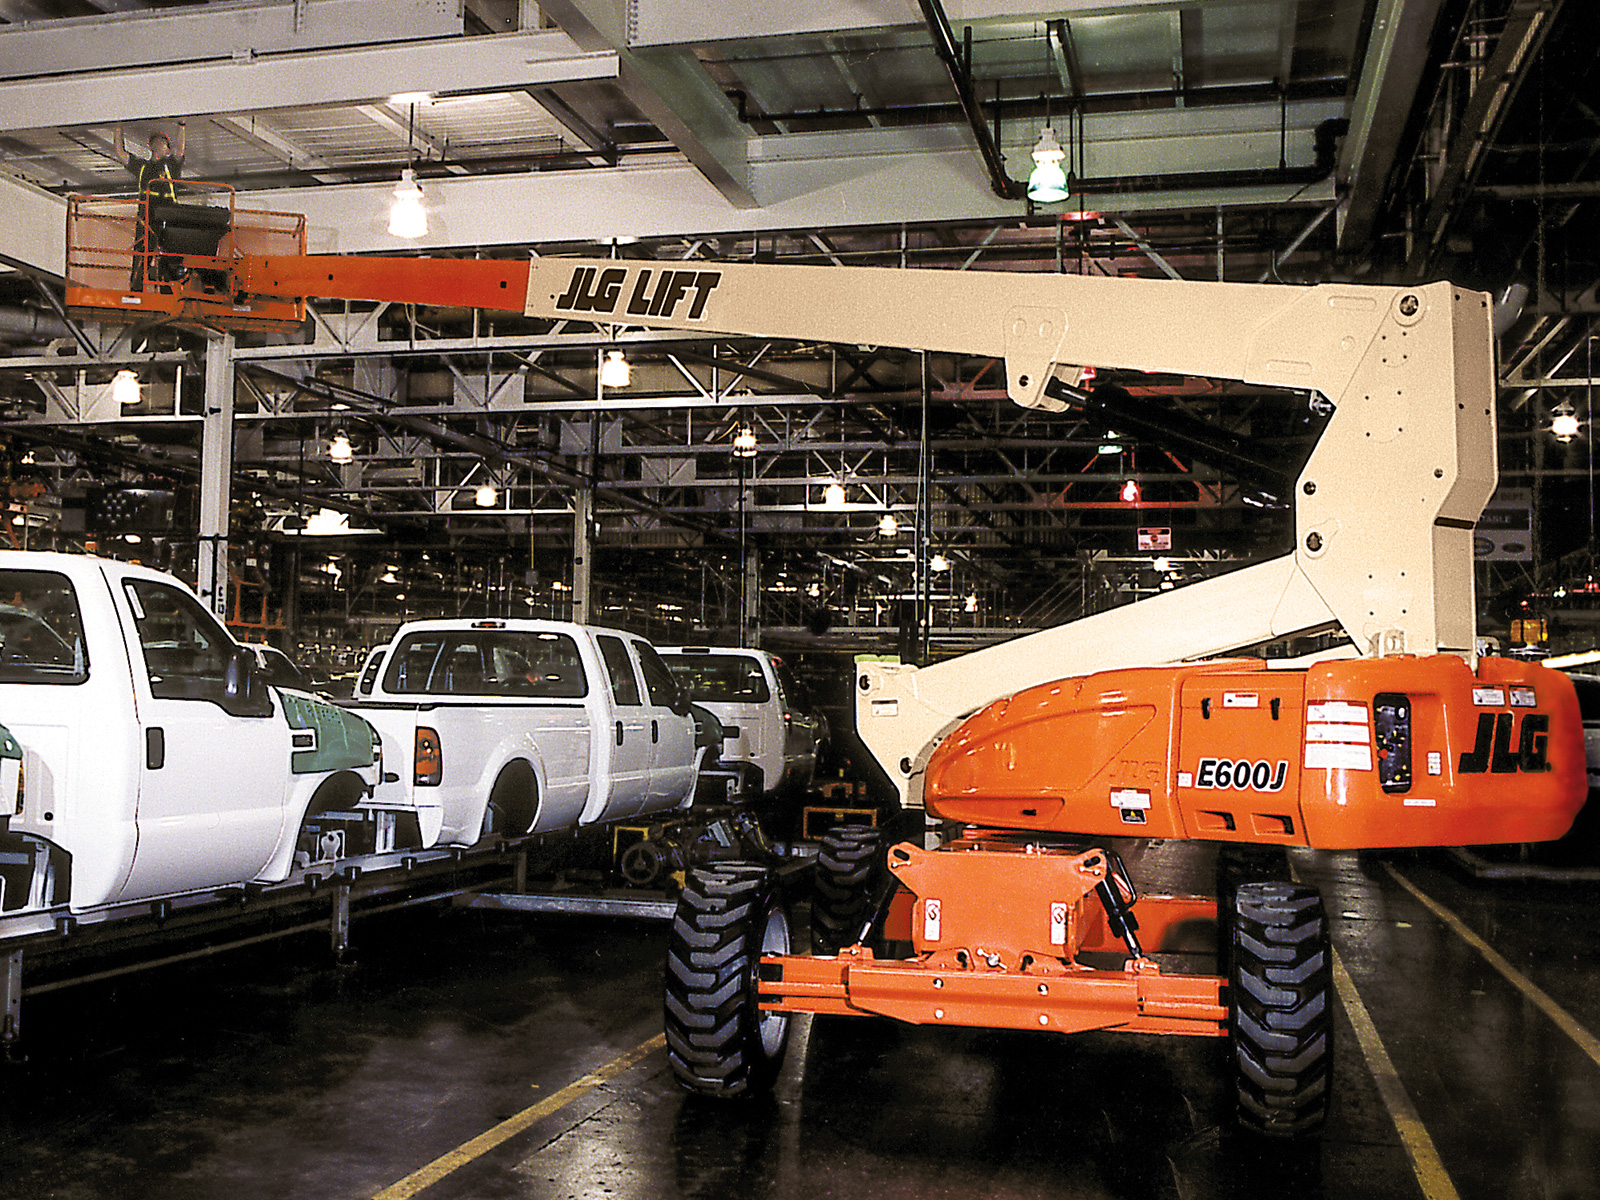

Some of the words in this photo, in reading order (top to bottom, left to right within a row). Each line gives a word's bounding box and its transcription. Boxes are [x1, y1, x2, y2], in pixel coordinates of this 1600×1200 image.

[556, 267, 627, 313] JLG
[626, 269, 722, 319] LIFT
[1458, 712, 1550, 774] JLG
[1196, 759, 1288, 791] E600J
